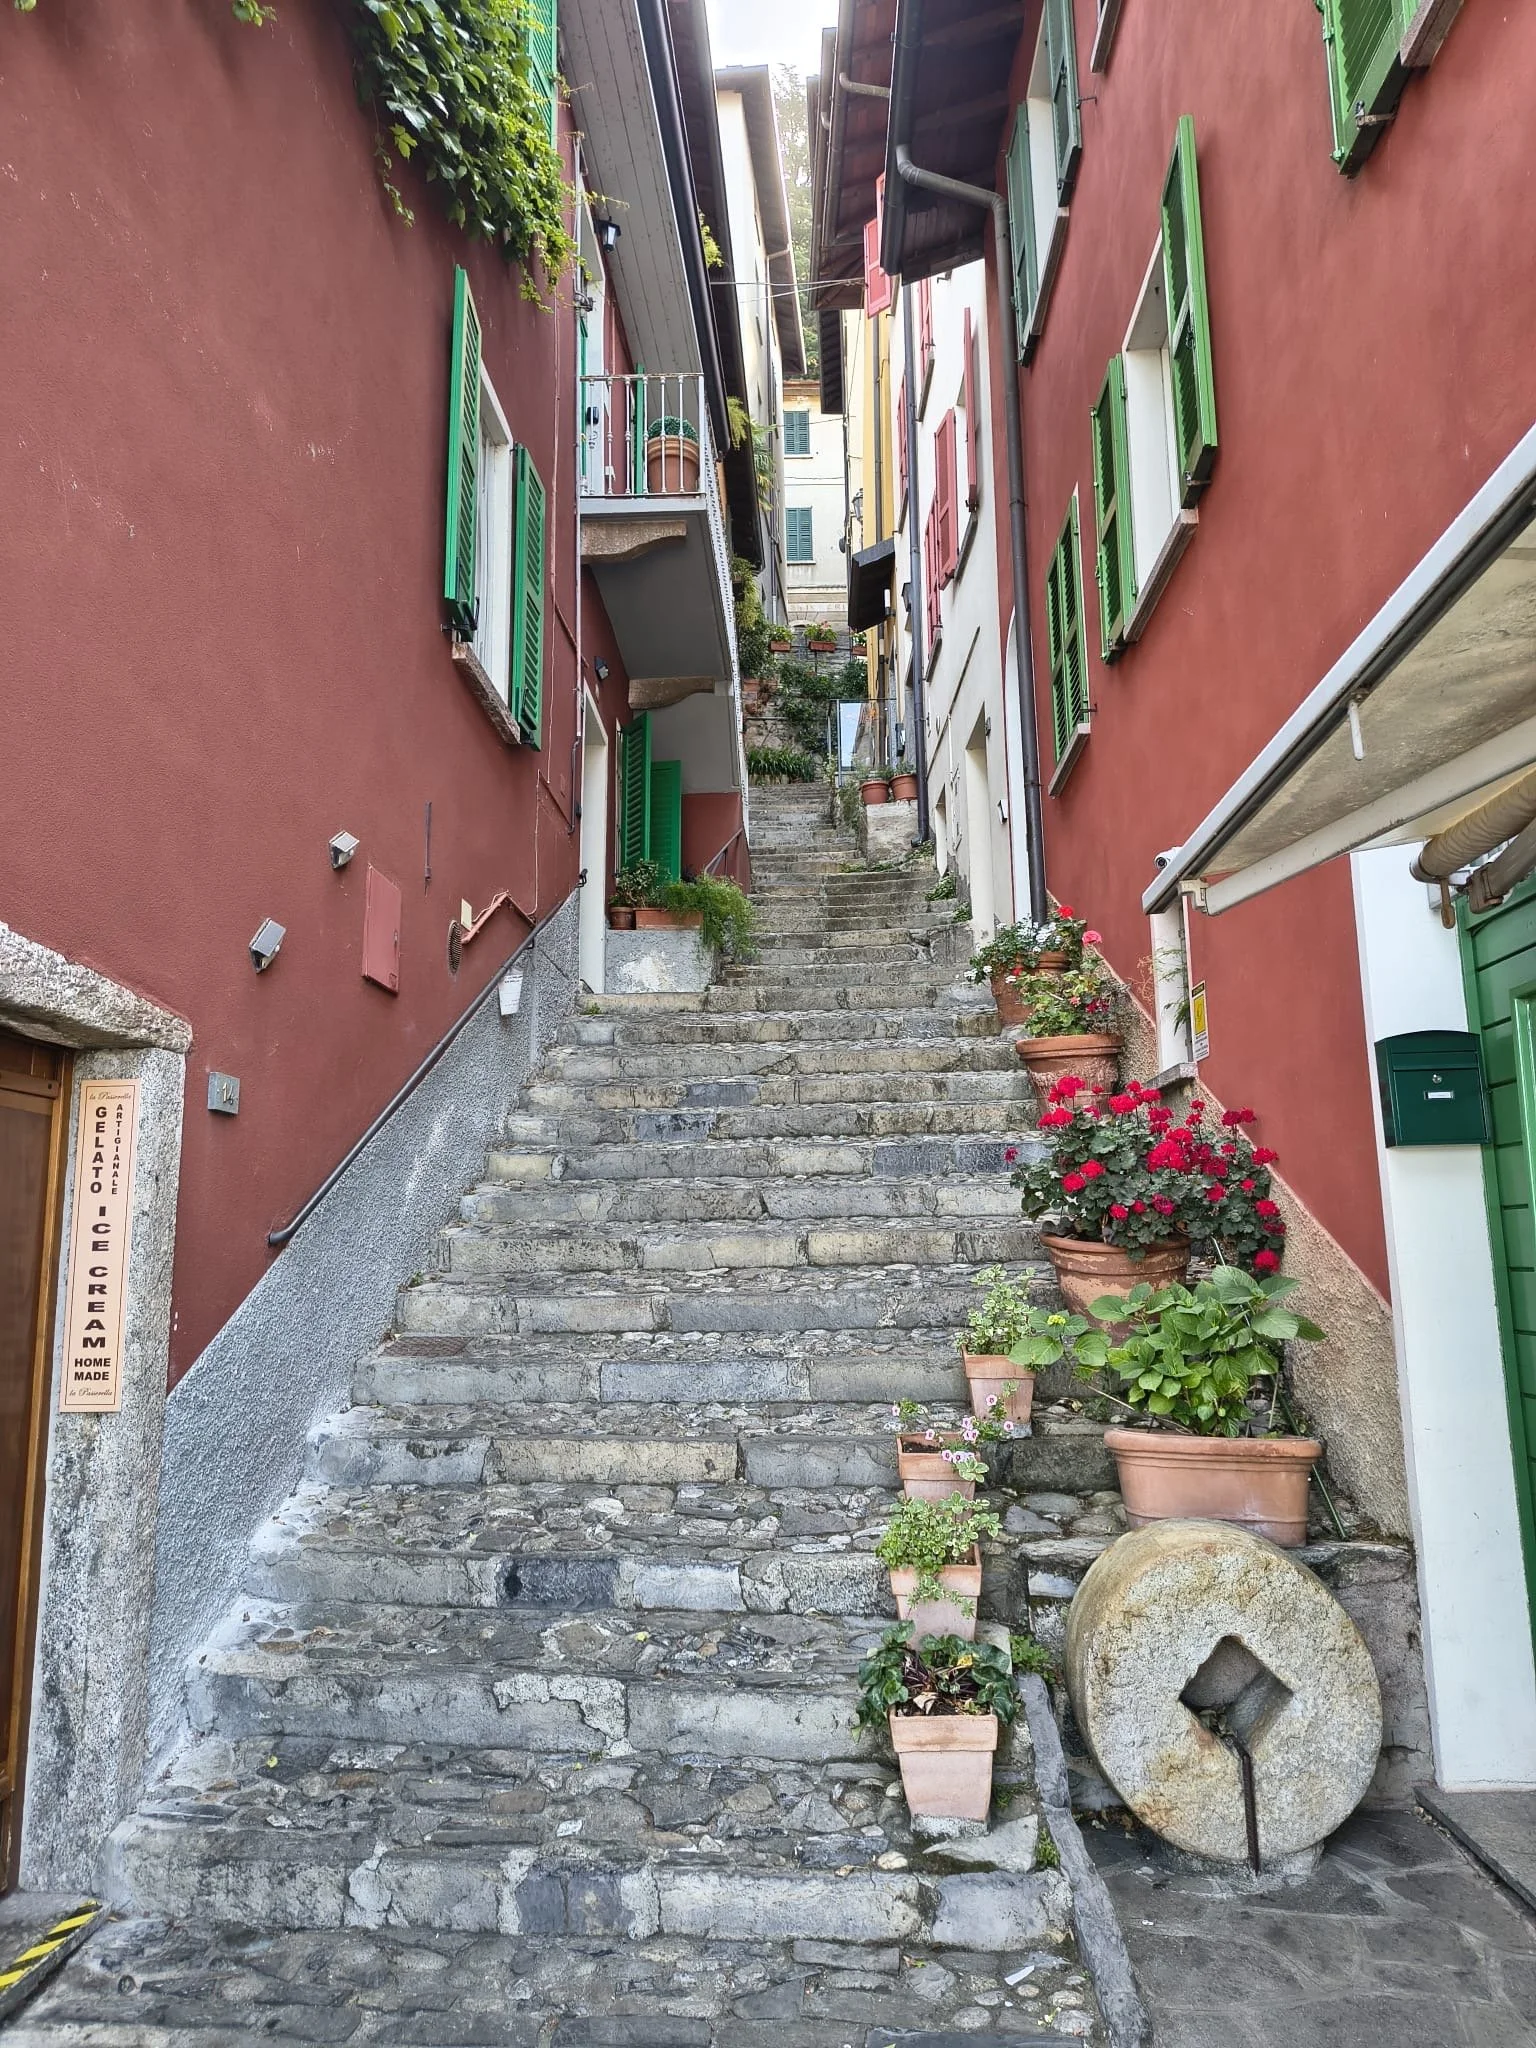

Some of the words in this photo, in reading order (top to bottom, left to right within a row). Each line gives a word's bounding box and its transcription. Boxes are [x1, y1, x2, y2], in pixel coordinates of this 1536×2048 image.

[90, 1106, 107, 1194] GELATO
[111, 1103, 123, 1195] ARTIGIANALE
[91, 1206, 111, 1252] ICE
[82, 1266, 108, 1348] CREAM
[74, 1358, 111, 1367] HOME
[74, 1371, 109, 1381] MADE
